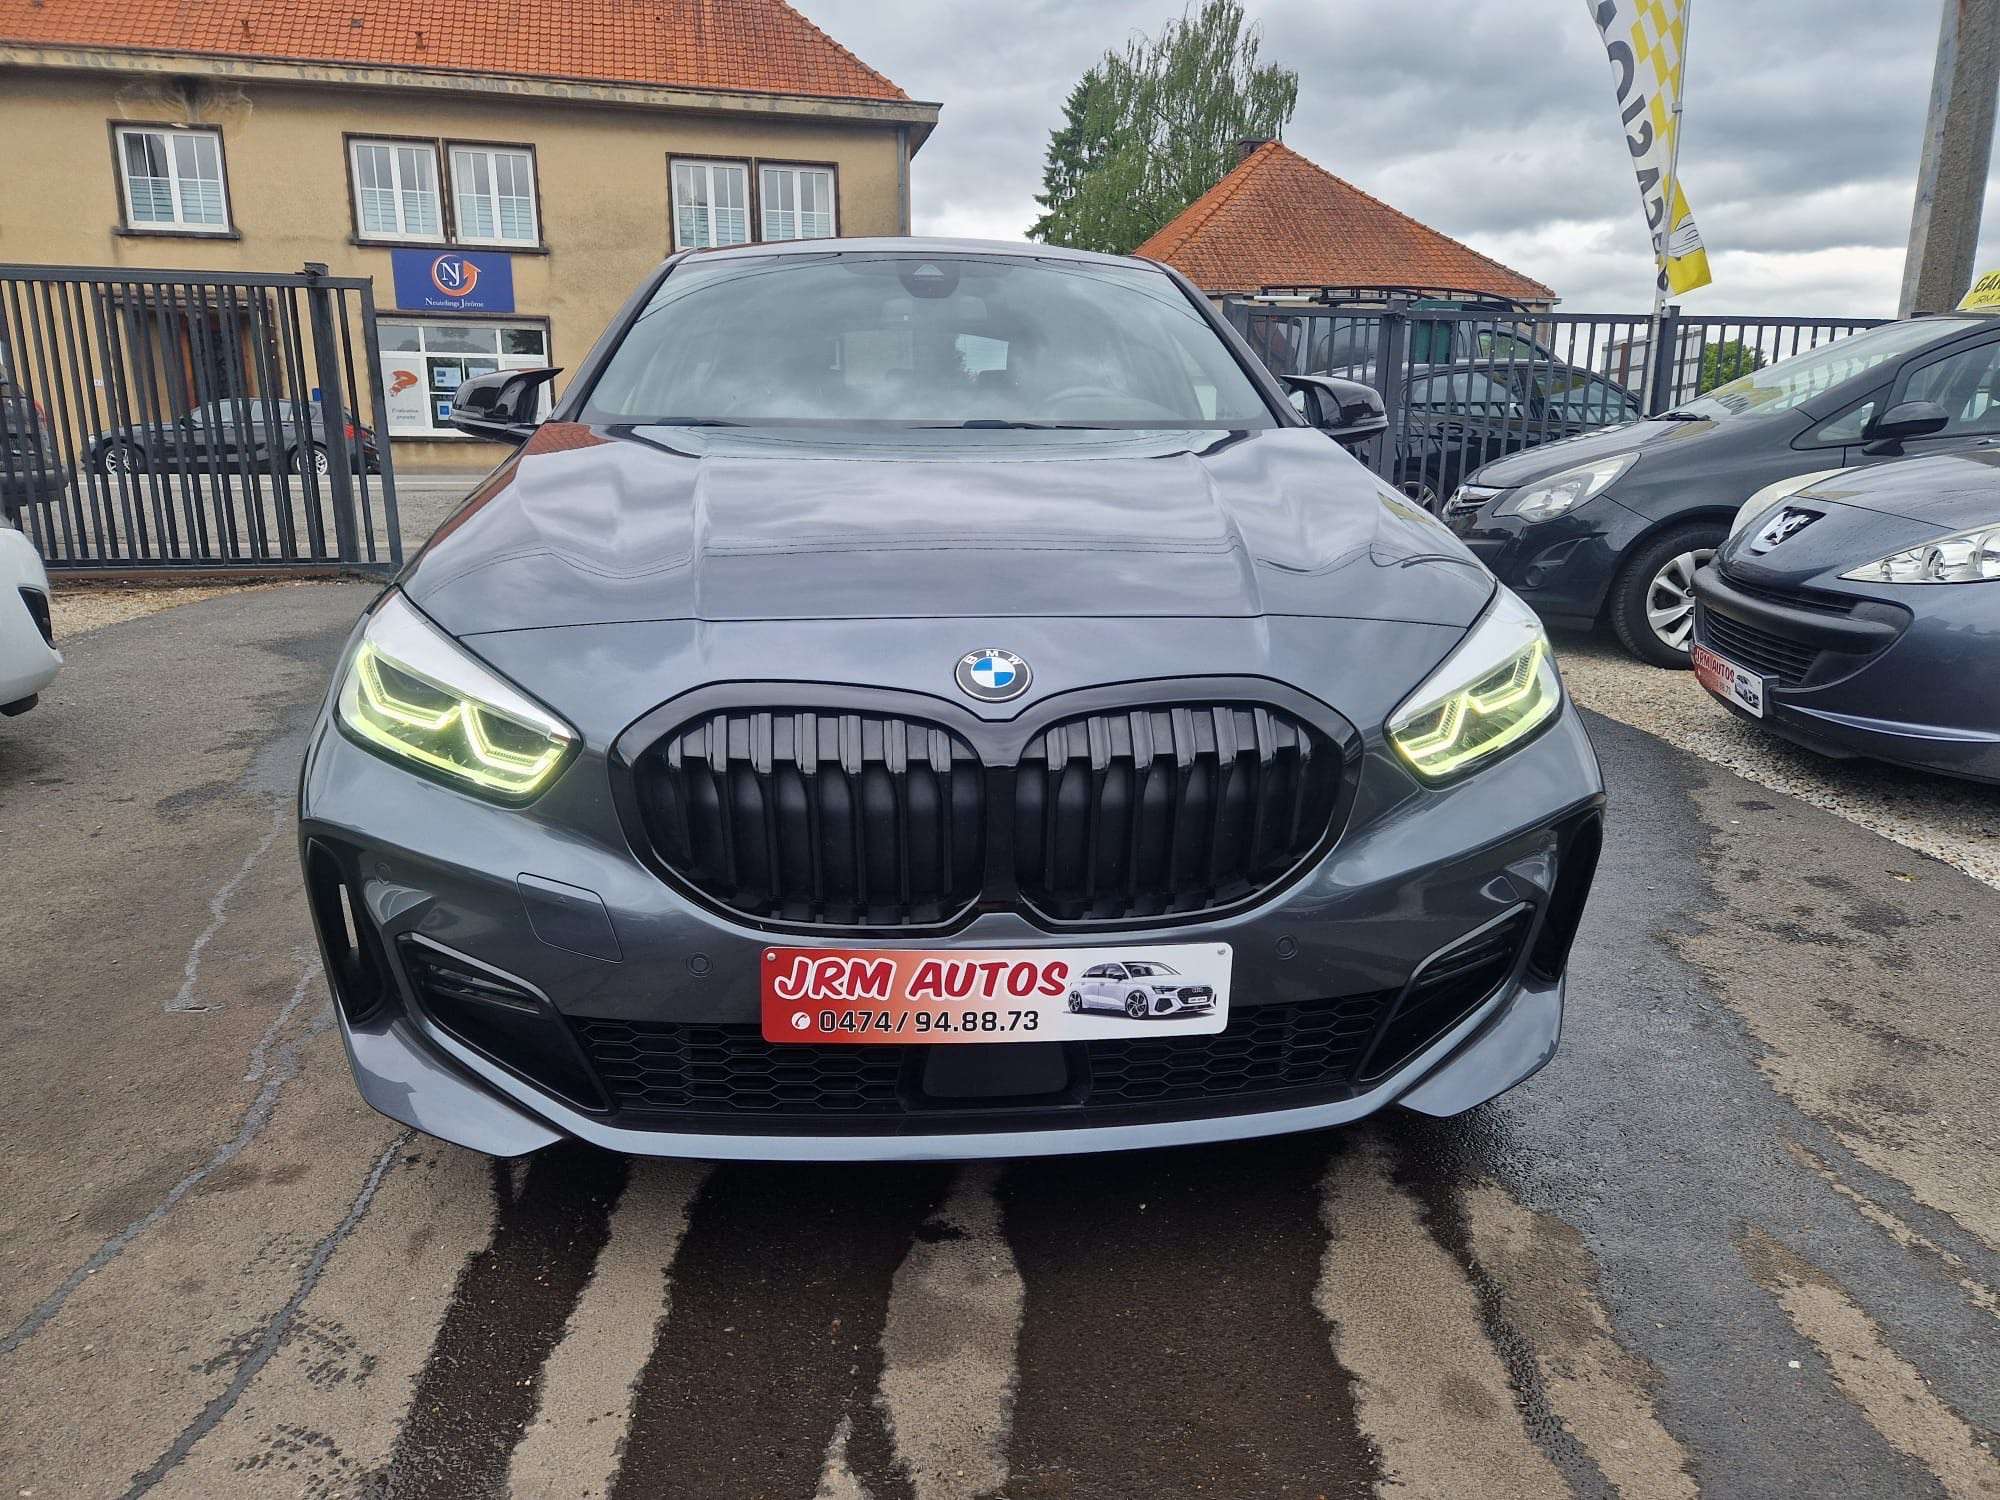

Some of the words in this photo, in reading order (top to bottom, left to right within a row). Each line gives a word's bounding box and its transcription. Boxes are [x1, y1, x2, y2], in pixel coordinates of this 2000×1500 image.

[963, 650, 1023, 665] BMW
[1712, 658, 1735, 683] AUTOS
[775, 957, 895, 1000] JRM
[906, 961, 1071, 1000] AUTOS
